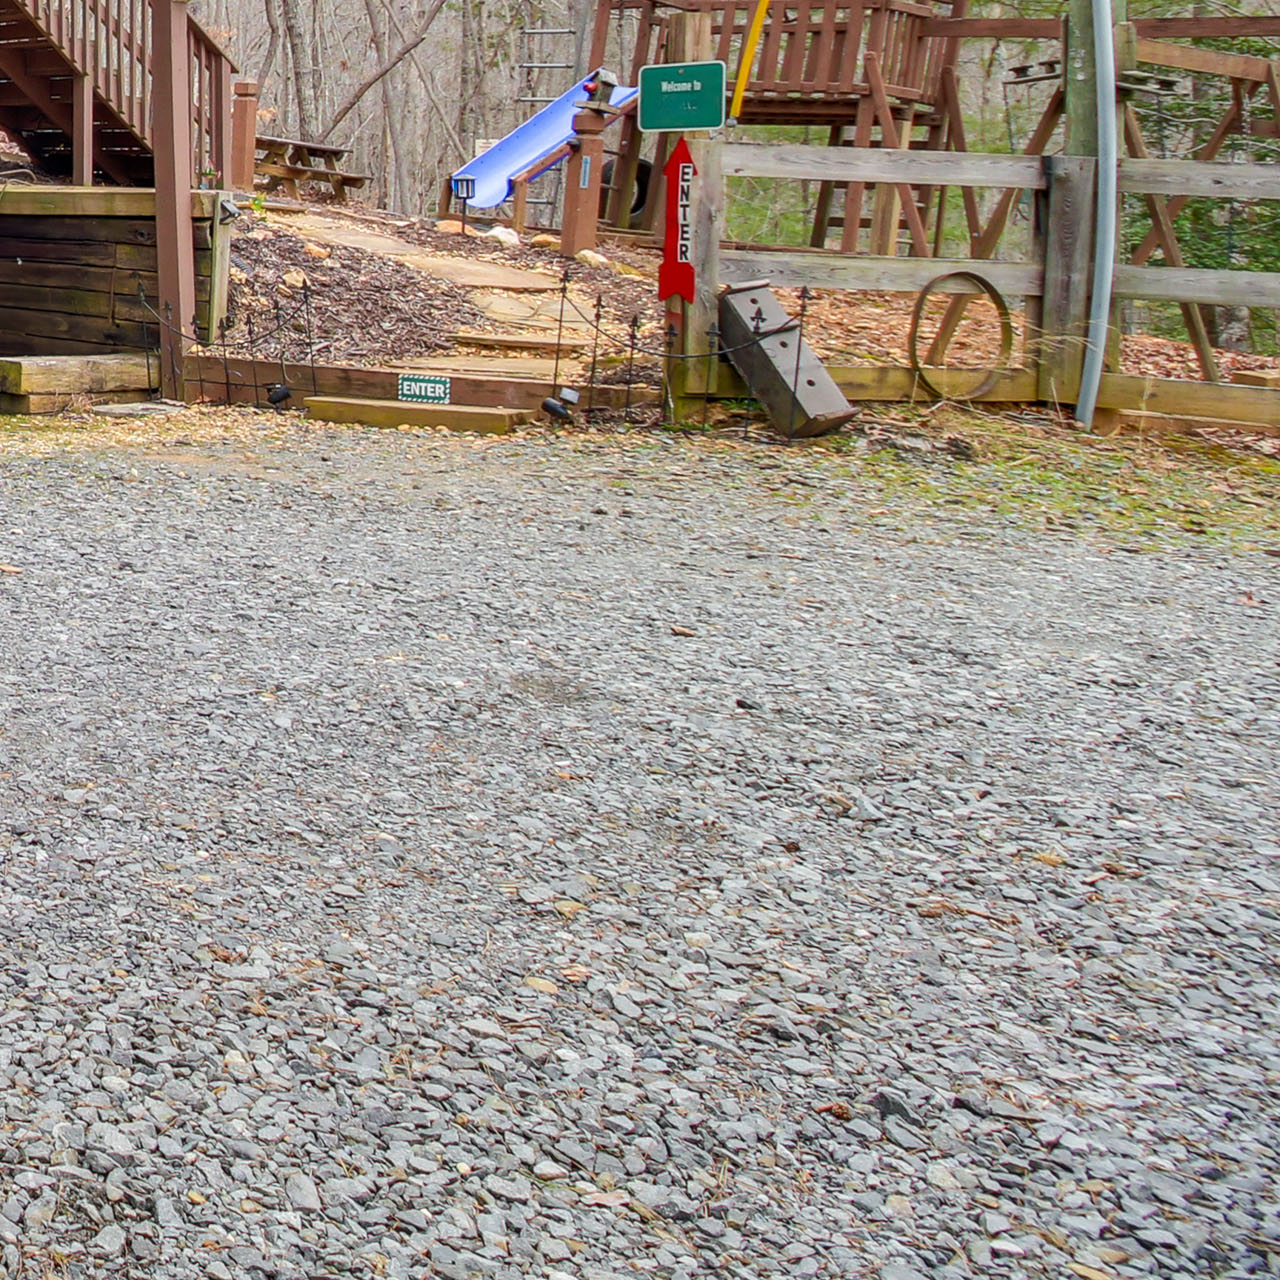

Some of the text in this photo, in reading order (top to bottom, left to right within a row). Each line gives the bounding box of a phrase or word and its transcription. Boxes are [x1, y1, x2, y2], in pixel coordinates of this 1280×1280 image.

[661, 80, 701, 92] Welcome to
[680, 165, 691, 261] ENTER
[403, 381, 445, 397] ENTER
